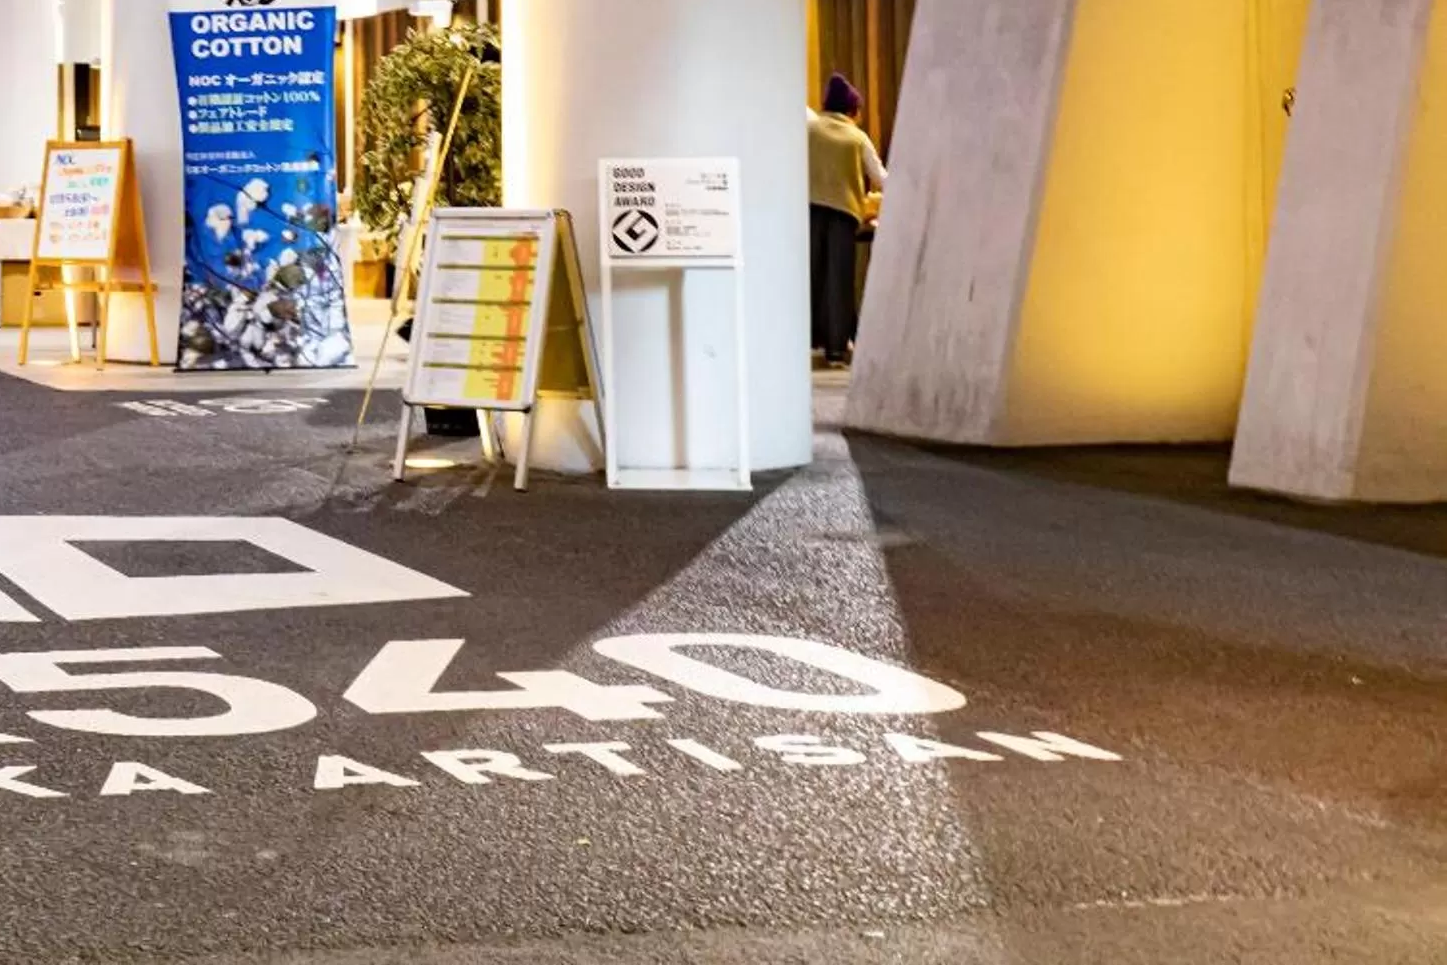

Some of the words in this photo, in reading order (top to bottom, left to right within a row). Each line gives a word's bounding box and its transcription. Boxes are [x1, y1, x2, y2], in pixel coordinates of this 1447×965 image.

[190, 11, 315, 34] ORGANIC
[191, 36, 303, 58] COTTON
[188, 75, 222, 88] NOC
[612, 167, 645, 179] GOOD
[613, 182, 656, 193] DESIGN
[312, 729, 1126, 791] ARTISAN
